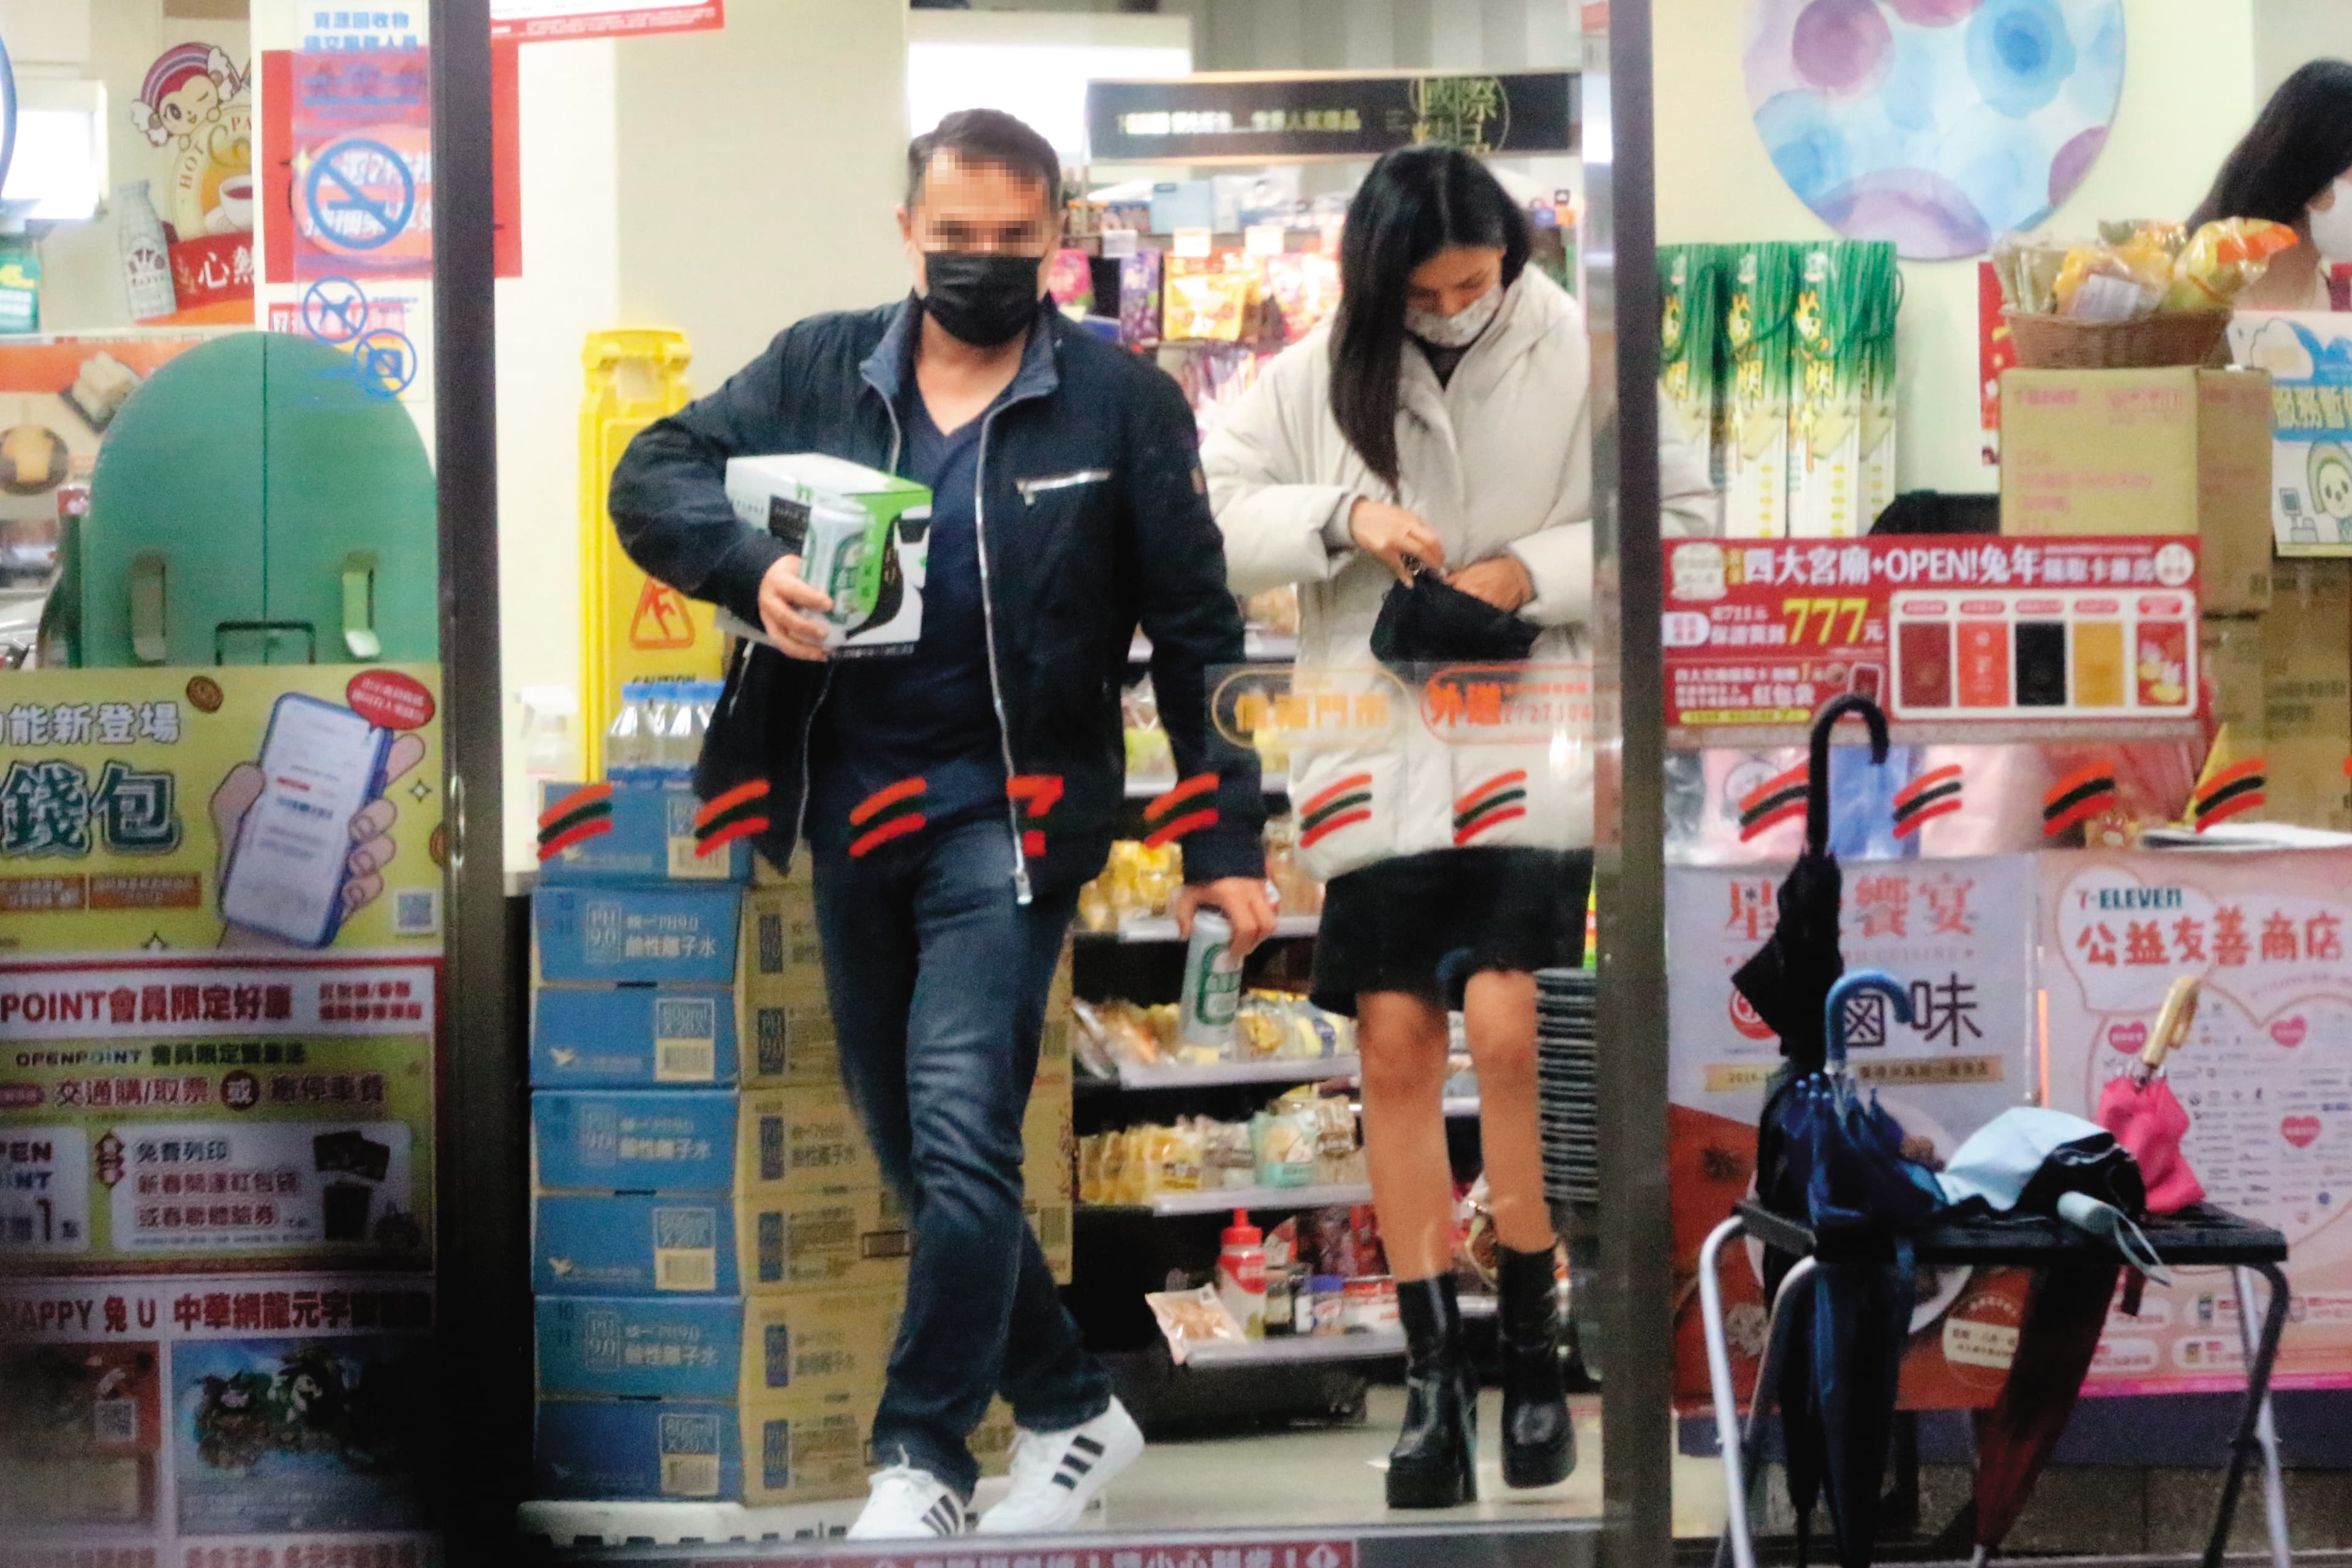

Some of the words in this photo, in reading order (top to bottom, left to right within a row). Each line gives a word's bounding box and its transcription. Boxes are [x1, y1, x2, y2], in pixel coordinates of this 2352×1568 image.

[1782, 598, 1868, 644] 777
[0, 702, 181, 745] 能新登場
[1, 760, 182, 856] 錢包
[2076, 905, 2343, 967] 公益友善商店
[137, 1299, 156, 1329] U
